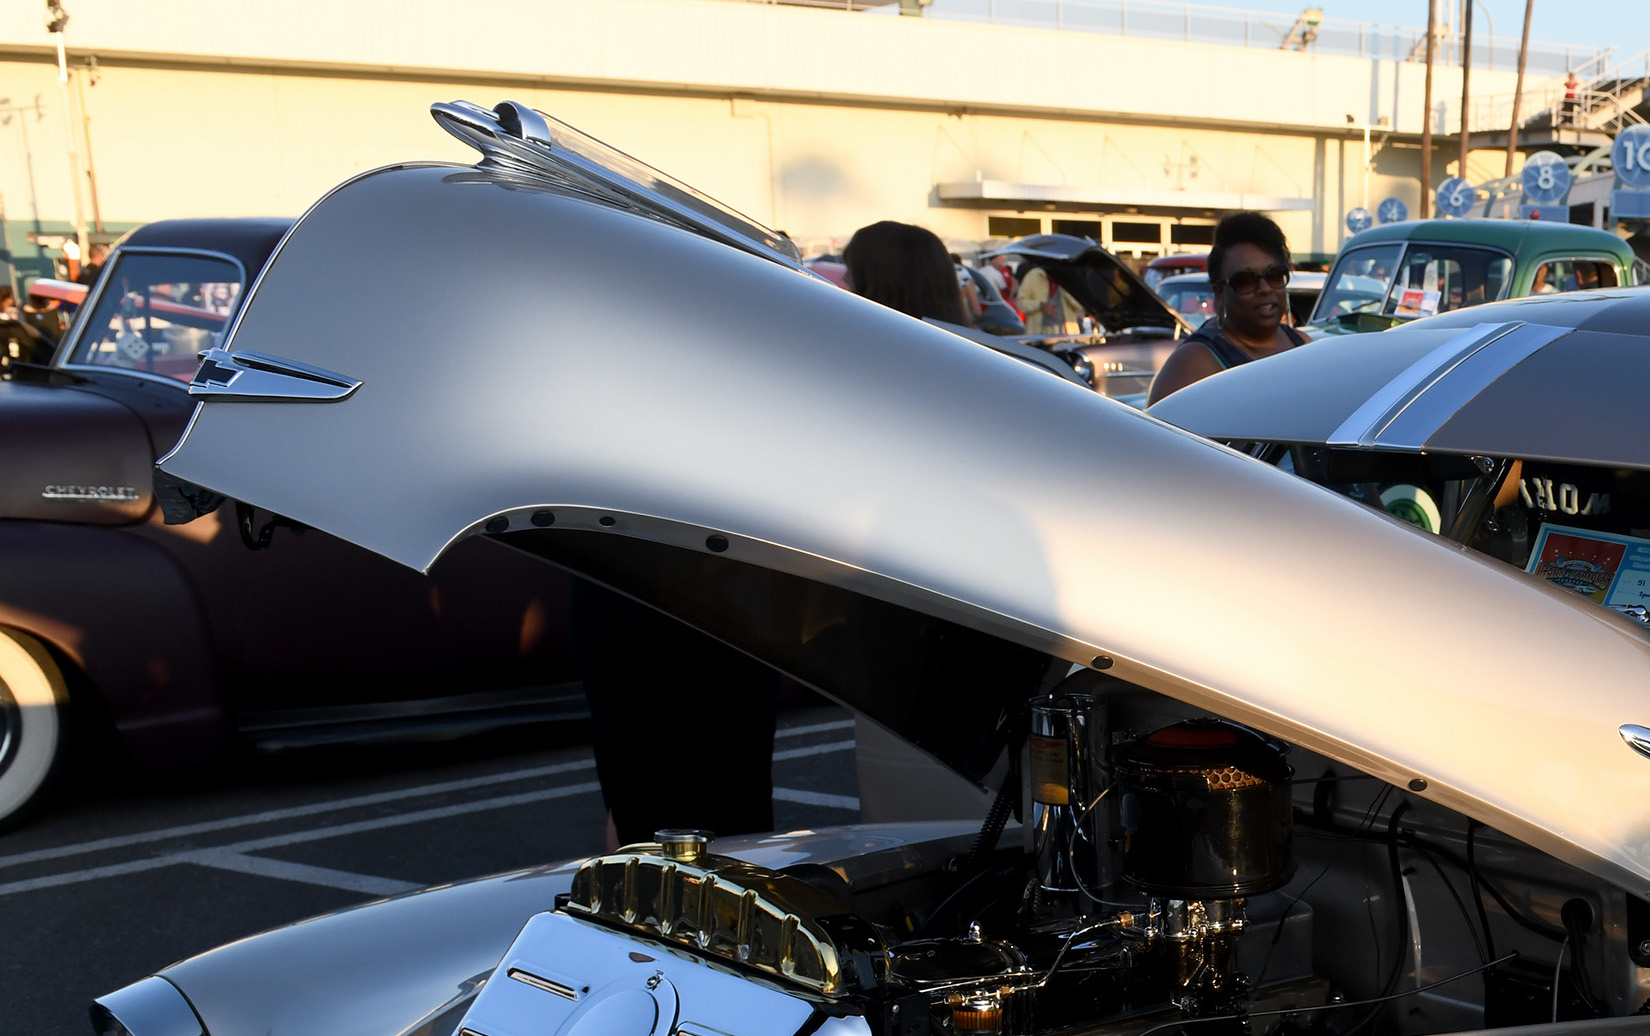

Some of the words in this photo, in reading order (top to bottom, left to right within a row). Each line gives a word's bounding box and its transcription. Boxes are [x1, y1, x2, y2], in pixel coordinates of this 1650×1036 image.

[1537, 166, 1555, 189] 8
[1450, 181, 1464, 207] 6
[45, 485, 136, 497] CHEVROLET
